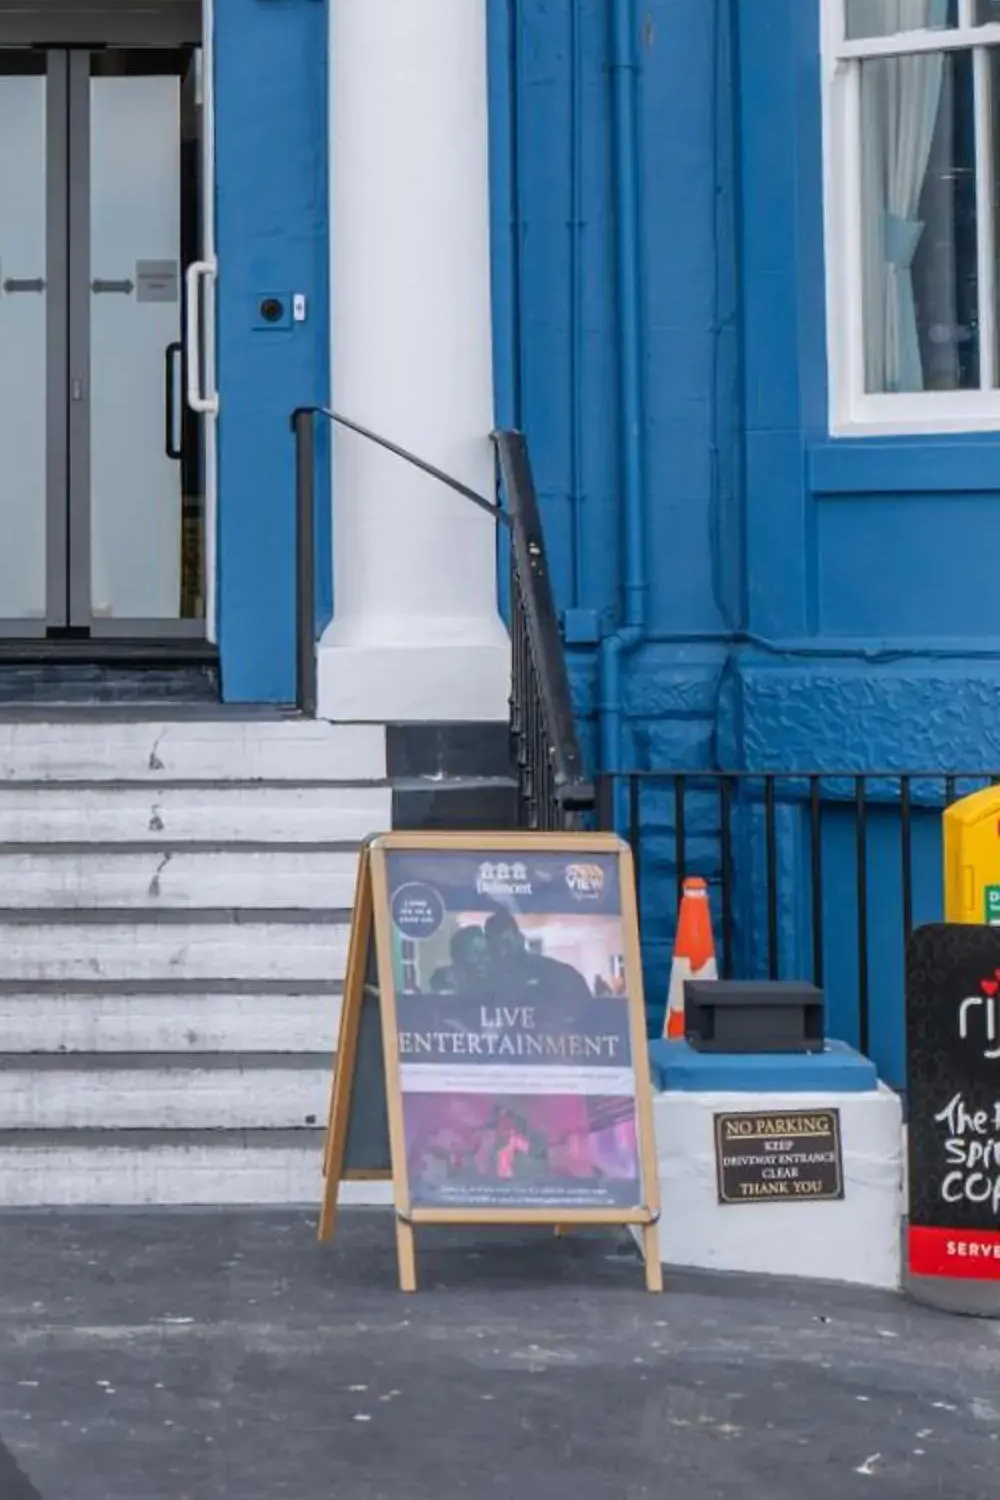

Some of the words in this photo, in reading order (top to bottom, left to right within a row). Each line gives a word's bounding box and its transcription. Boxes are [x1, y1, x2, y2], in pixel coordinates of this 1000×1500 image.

[480, 1005, 536, 1029] LIVE
[398, 1030, 620, 1058] ENTERTAINMENT
[934, 1091, 988, 1135] The
[725, 1120, 753, 1135] NO
[756, 1116, 829, 1134] PARKING
[764, 1140, 794, 1151] KEEP
[778, 1151, 835, 1164] ENTRANCE
[761, 1167, 799, 1179] CLEAR
[739, 1181, 790, 1196] THANK
[791, 1180, 823, 1194] YOU
